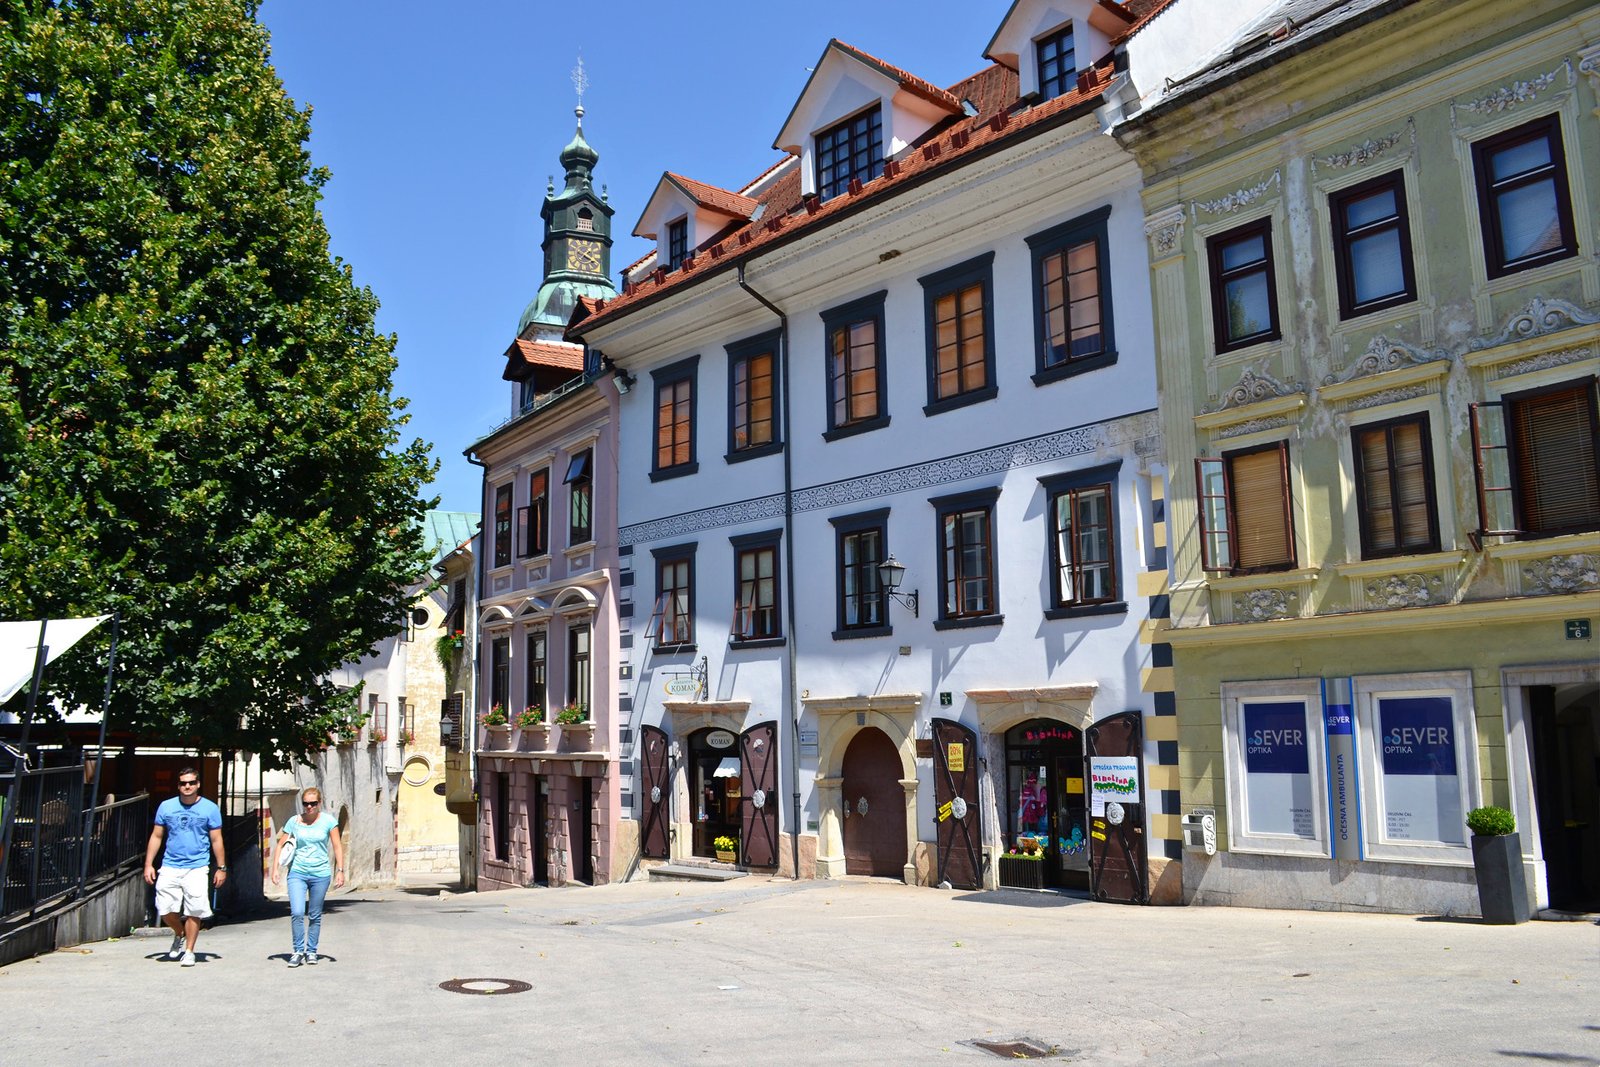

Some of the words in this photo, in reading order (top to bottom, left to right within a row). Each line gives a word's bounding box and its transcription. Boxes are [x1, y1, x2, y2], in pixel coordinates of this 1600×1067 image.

[1575, 630, 1582, 638] 6
[671, 684, 696, 692] KOMAN
[1329, 716, 1350, 724] SEVER
[1254, 729, 1303, 746] SEVER
[1391, 727, 1450, 745] SEVER
[1248, 746, 1272, 754] OPTIKA
[1384, 746, 1413, 754] OPTIKA
[1336, 753, 1346, 807] AMBULANTA
[1339, 808, 1348, 841] OČESNA
